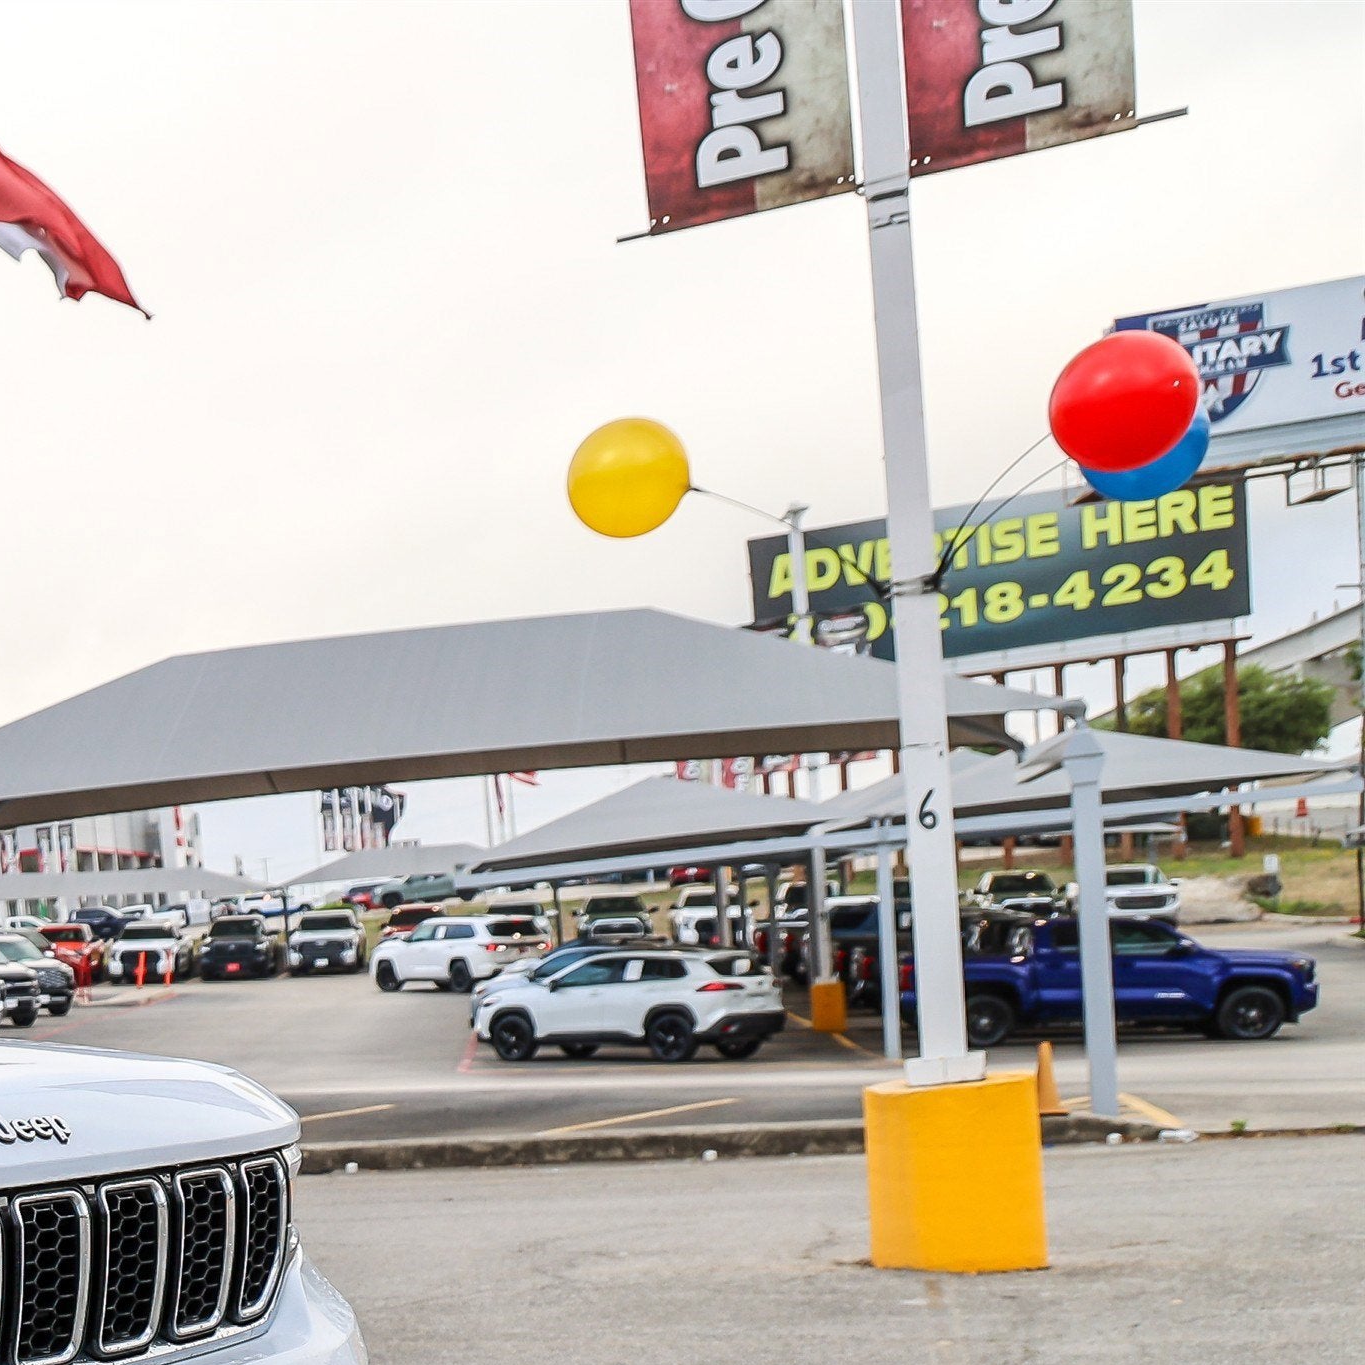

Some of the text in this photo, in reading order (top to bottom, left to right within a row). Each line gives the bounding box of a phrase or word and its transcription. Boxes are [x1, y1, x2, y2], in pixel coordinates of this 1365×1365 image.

[696, 30, 790, 189] Pre
[1191, 329, 1283, 367] ITARY
[1311, 350, 1361, 379] 1st
[767, 484, 1235, 599] ADVETISE HERE
[918, 788, 936, 830] 6
